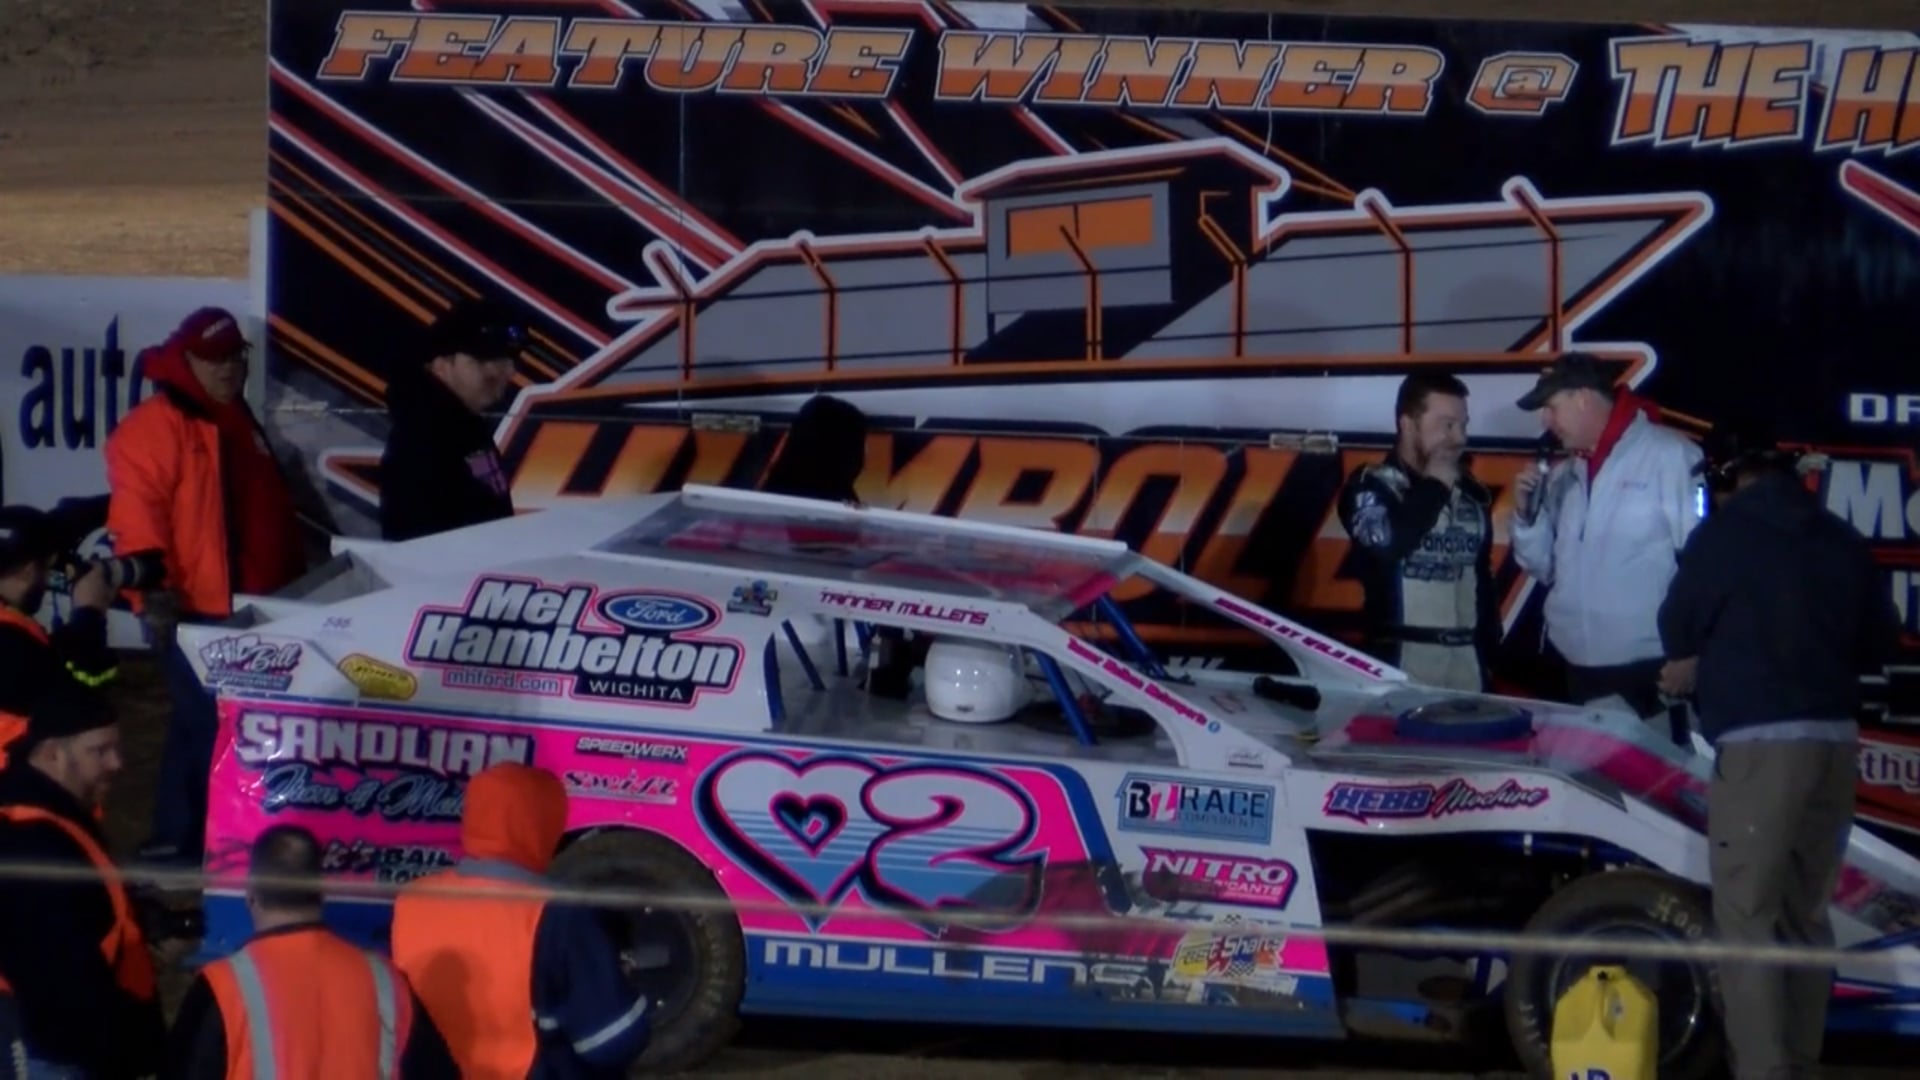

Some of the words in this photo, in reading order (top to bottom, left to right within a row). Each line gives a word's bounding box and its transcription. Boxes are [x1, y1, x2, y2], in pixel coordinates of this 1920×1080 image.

[318, 11, 912, 98] FEATURE
[934, 31, 1447, 115] WINNER
[1609, 35, 1813, 147] THE
[468, 579, 592, 627] Mel
[626, 600, 685, 625] Ford
[819, 590, 895, 614] TANNER
[896, 601, 989, 626] MULLENS
[246, 641, 303, 673] Bill
[410, 612, 740, 685] Hambelton
[446, 668, 559, 694] mhford.com
[588, 679, 684, 701] WICHITA
[238, 711, 533, 779] SANDLIAN
[576, 736, 689, 760] SPEEDWERX
[1180, 786, 1266, 819] RACE
[1329, 786, 1434, 815] HEBB
[1151, 853, 1289, 885] NITRO
[764, 940, 1148, 985] MULLENS
